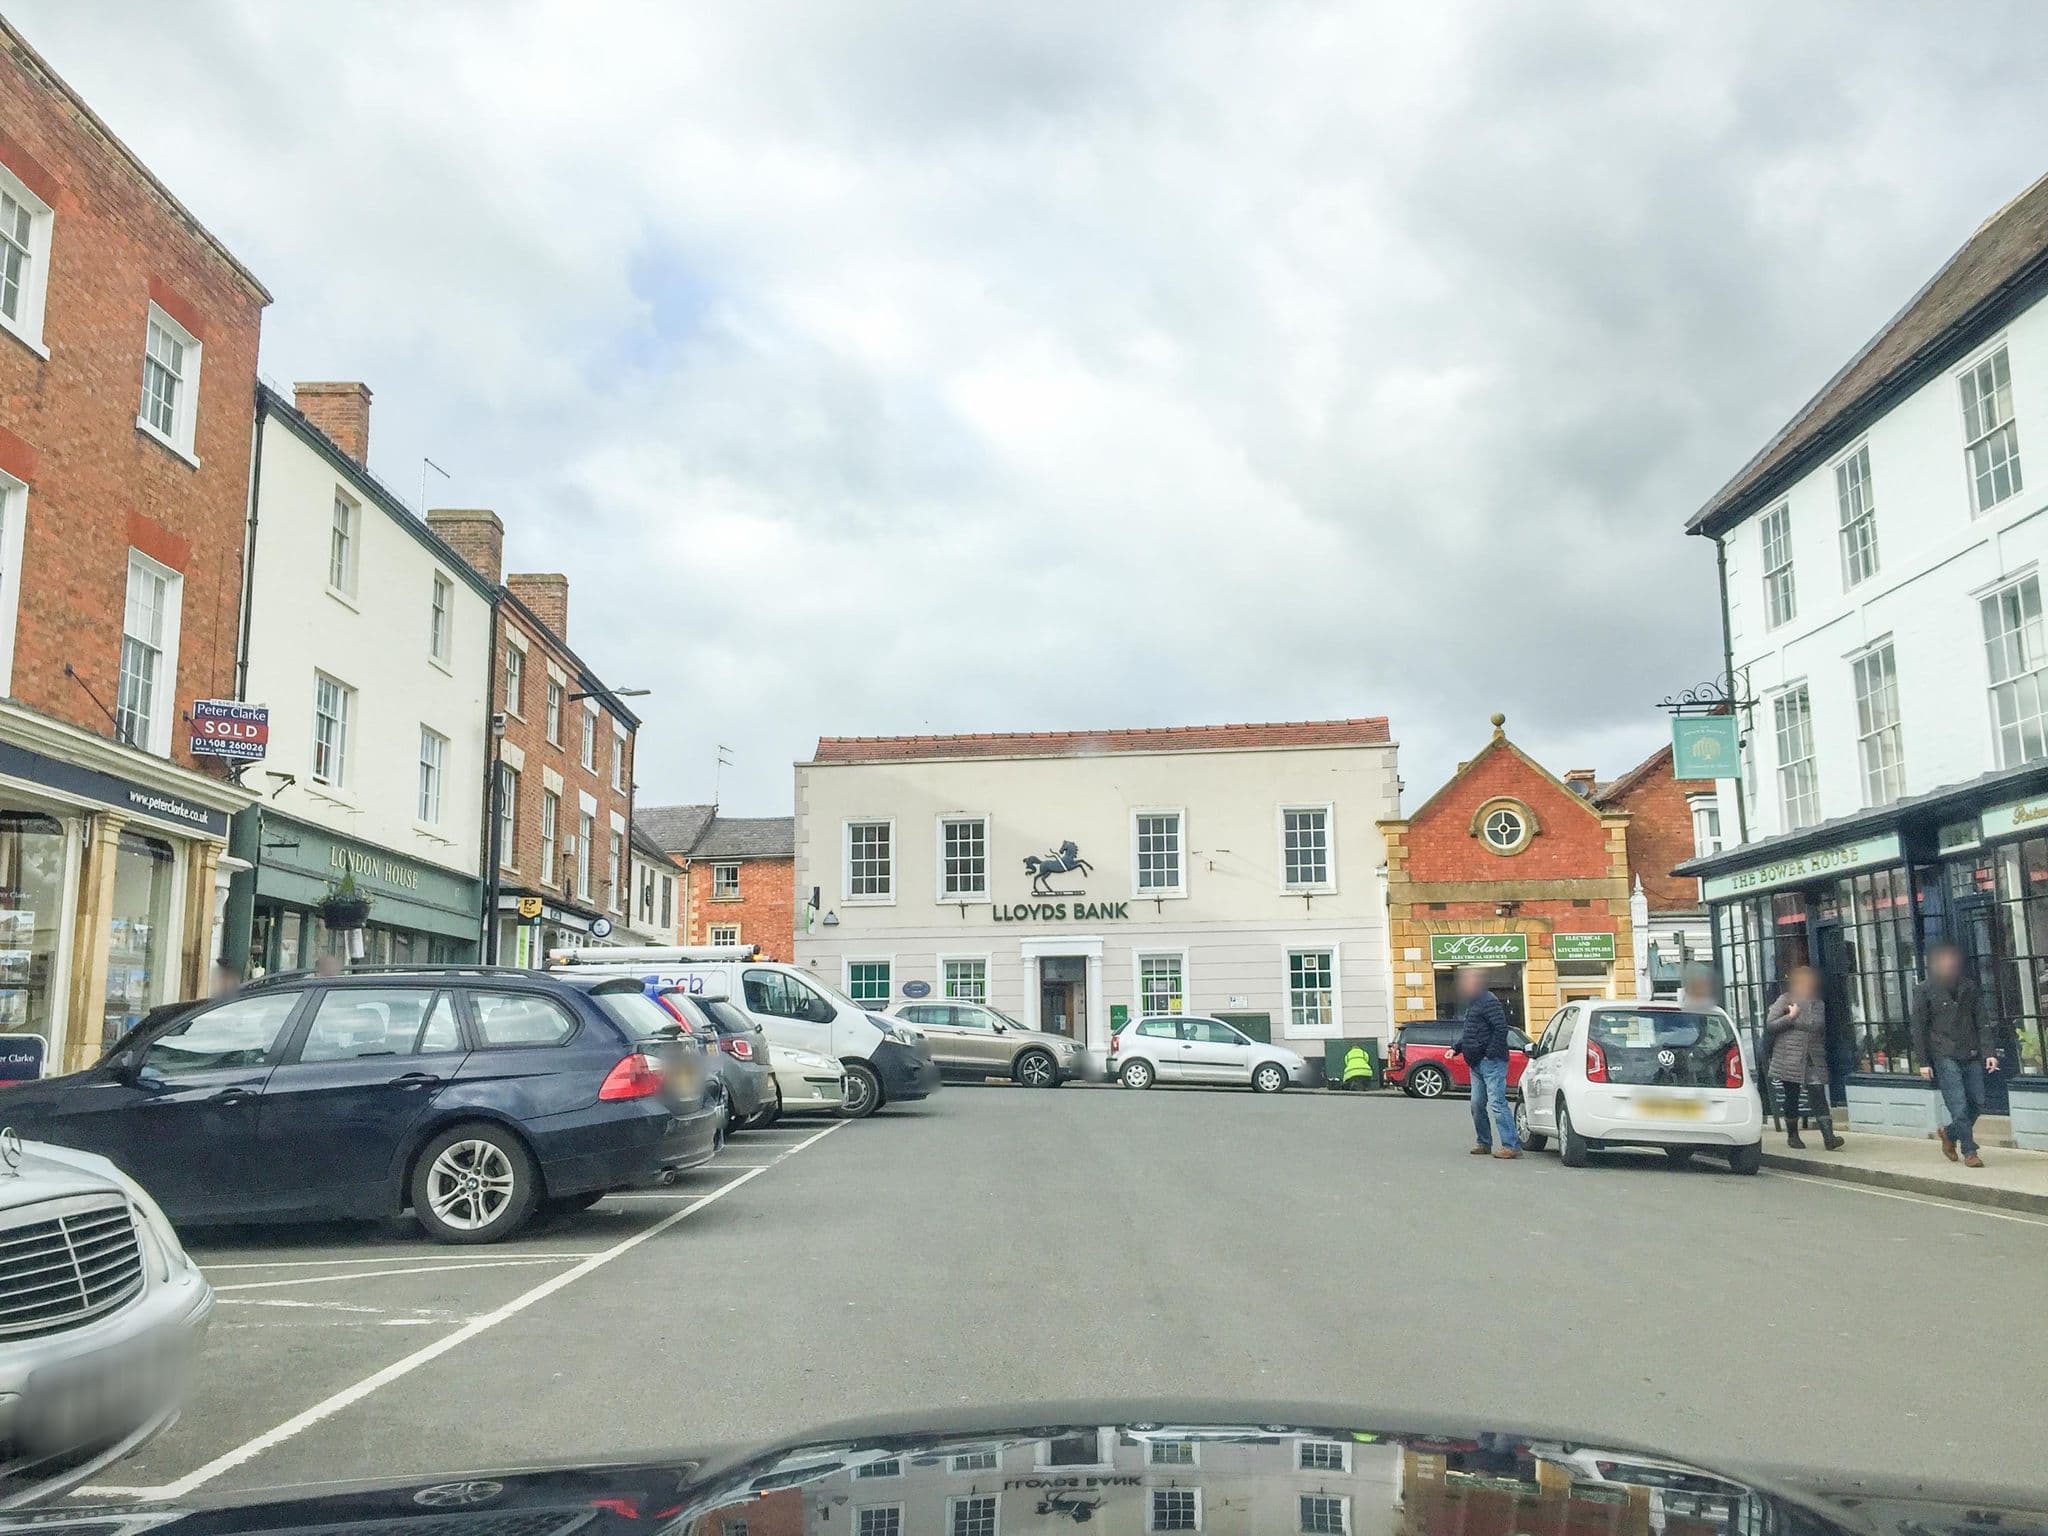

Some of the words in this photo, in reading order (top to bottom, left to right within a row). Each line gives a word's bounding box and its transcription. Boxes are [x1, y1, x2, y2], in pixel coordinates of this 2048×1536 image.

[197, 703, 228, 717] Peter
[231, 707, 266, 721] Clarke
[204, 720, 258, 738] SOLD
[229, 741, 264, 752] 260026
[130, 791, 208, 824] www.peterclarke.co.uk
[331, 846, 379, 878] LONDON
[384, 862, 418, 890] HOUSE
[1732, 873, 1756, 890] THE
[1759, 861, 1806, 884] BOWER
[1810, 847, 1859, 872] HOUSE
[993, 903, 1067, 921] LLOYDS
[1073, 902, 1129, 920] BANK
[1438, 937, 1465, 954] A
[1464, 936, 1520, 954] Clarke
[8, 1053, 35, 1063] Clarke
